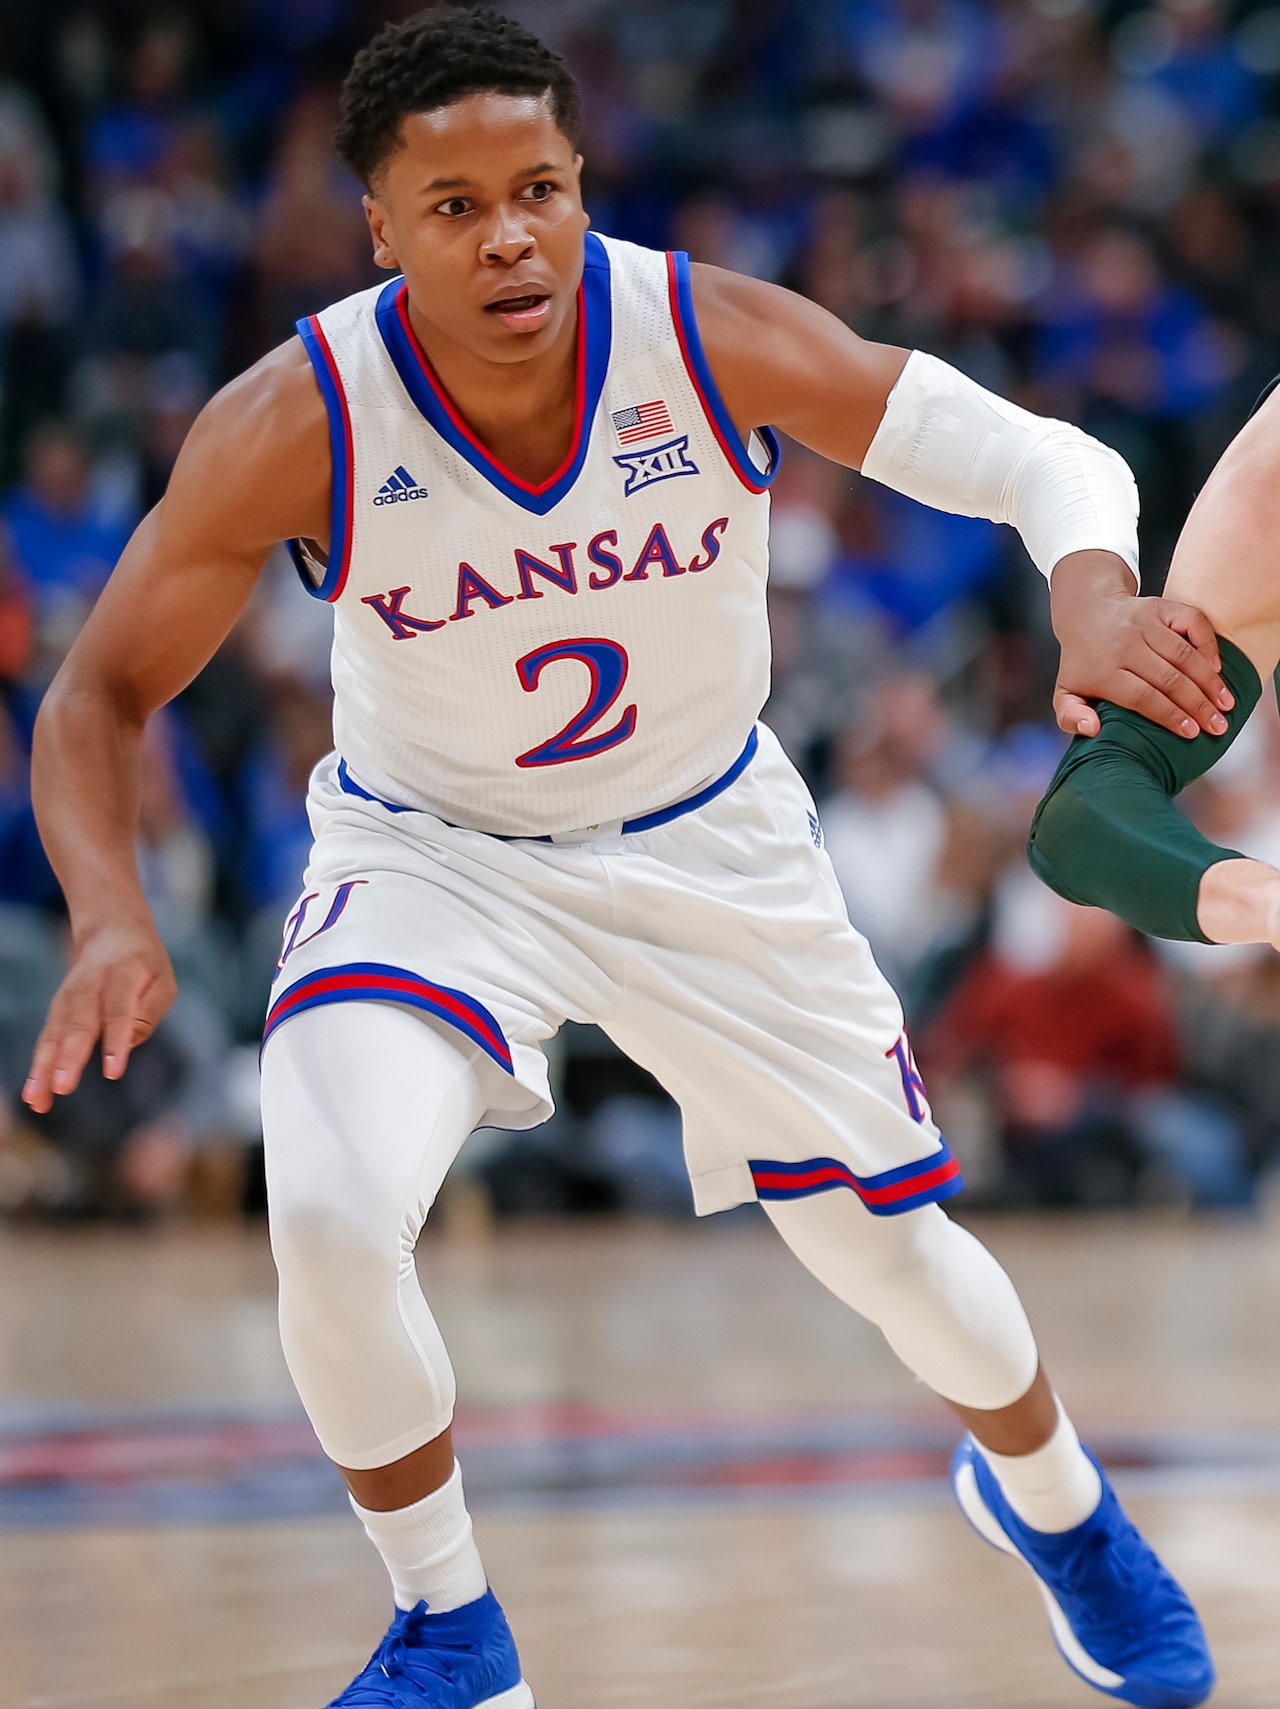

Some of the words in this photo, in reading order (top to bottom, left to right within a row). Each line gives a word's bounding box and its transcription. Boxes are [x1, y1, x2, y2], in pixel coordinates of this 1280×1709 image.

[373, 487, 428, 506] adidas
[361, 517, 730, 640] KANSAS
[516, 637, 638, 768] 2
